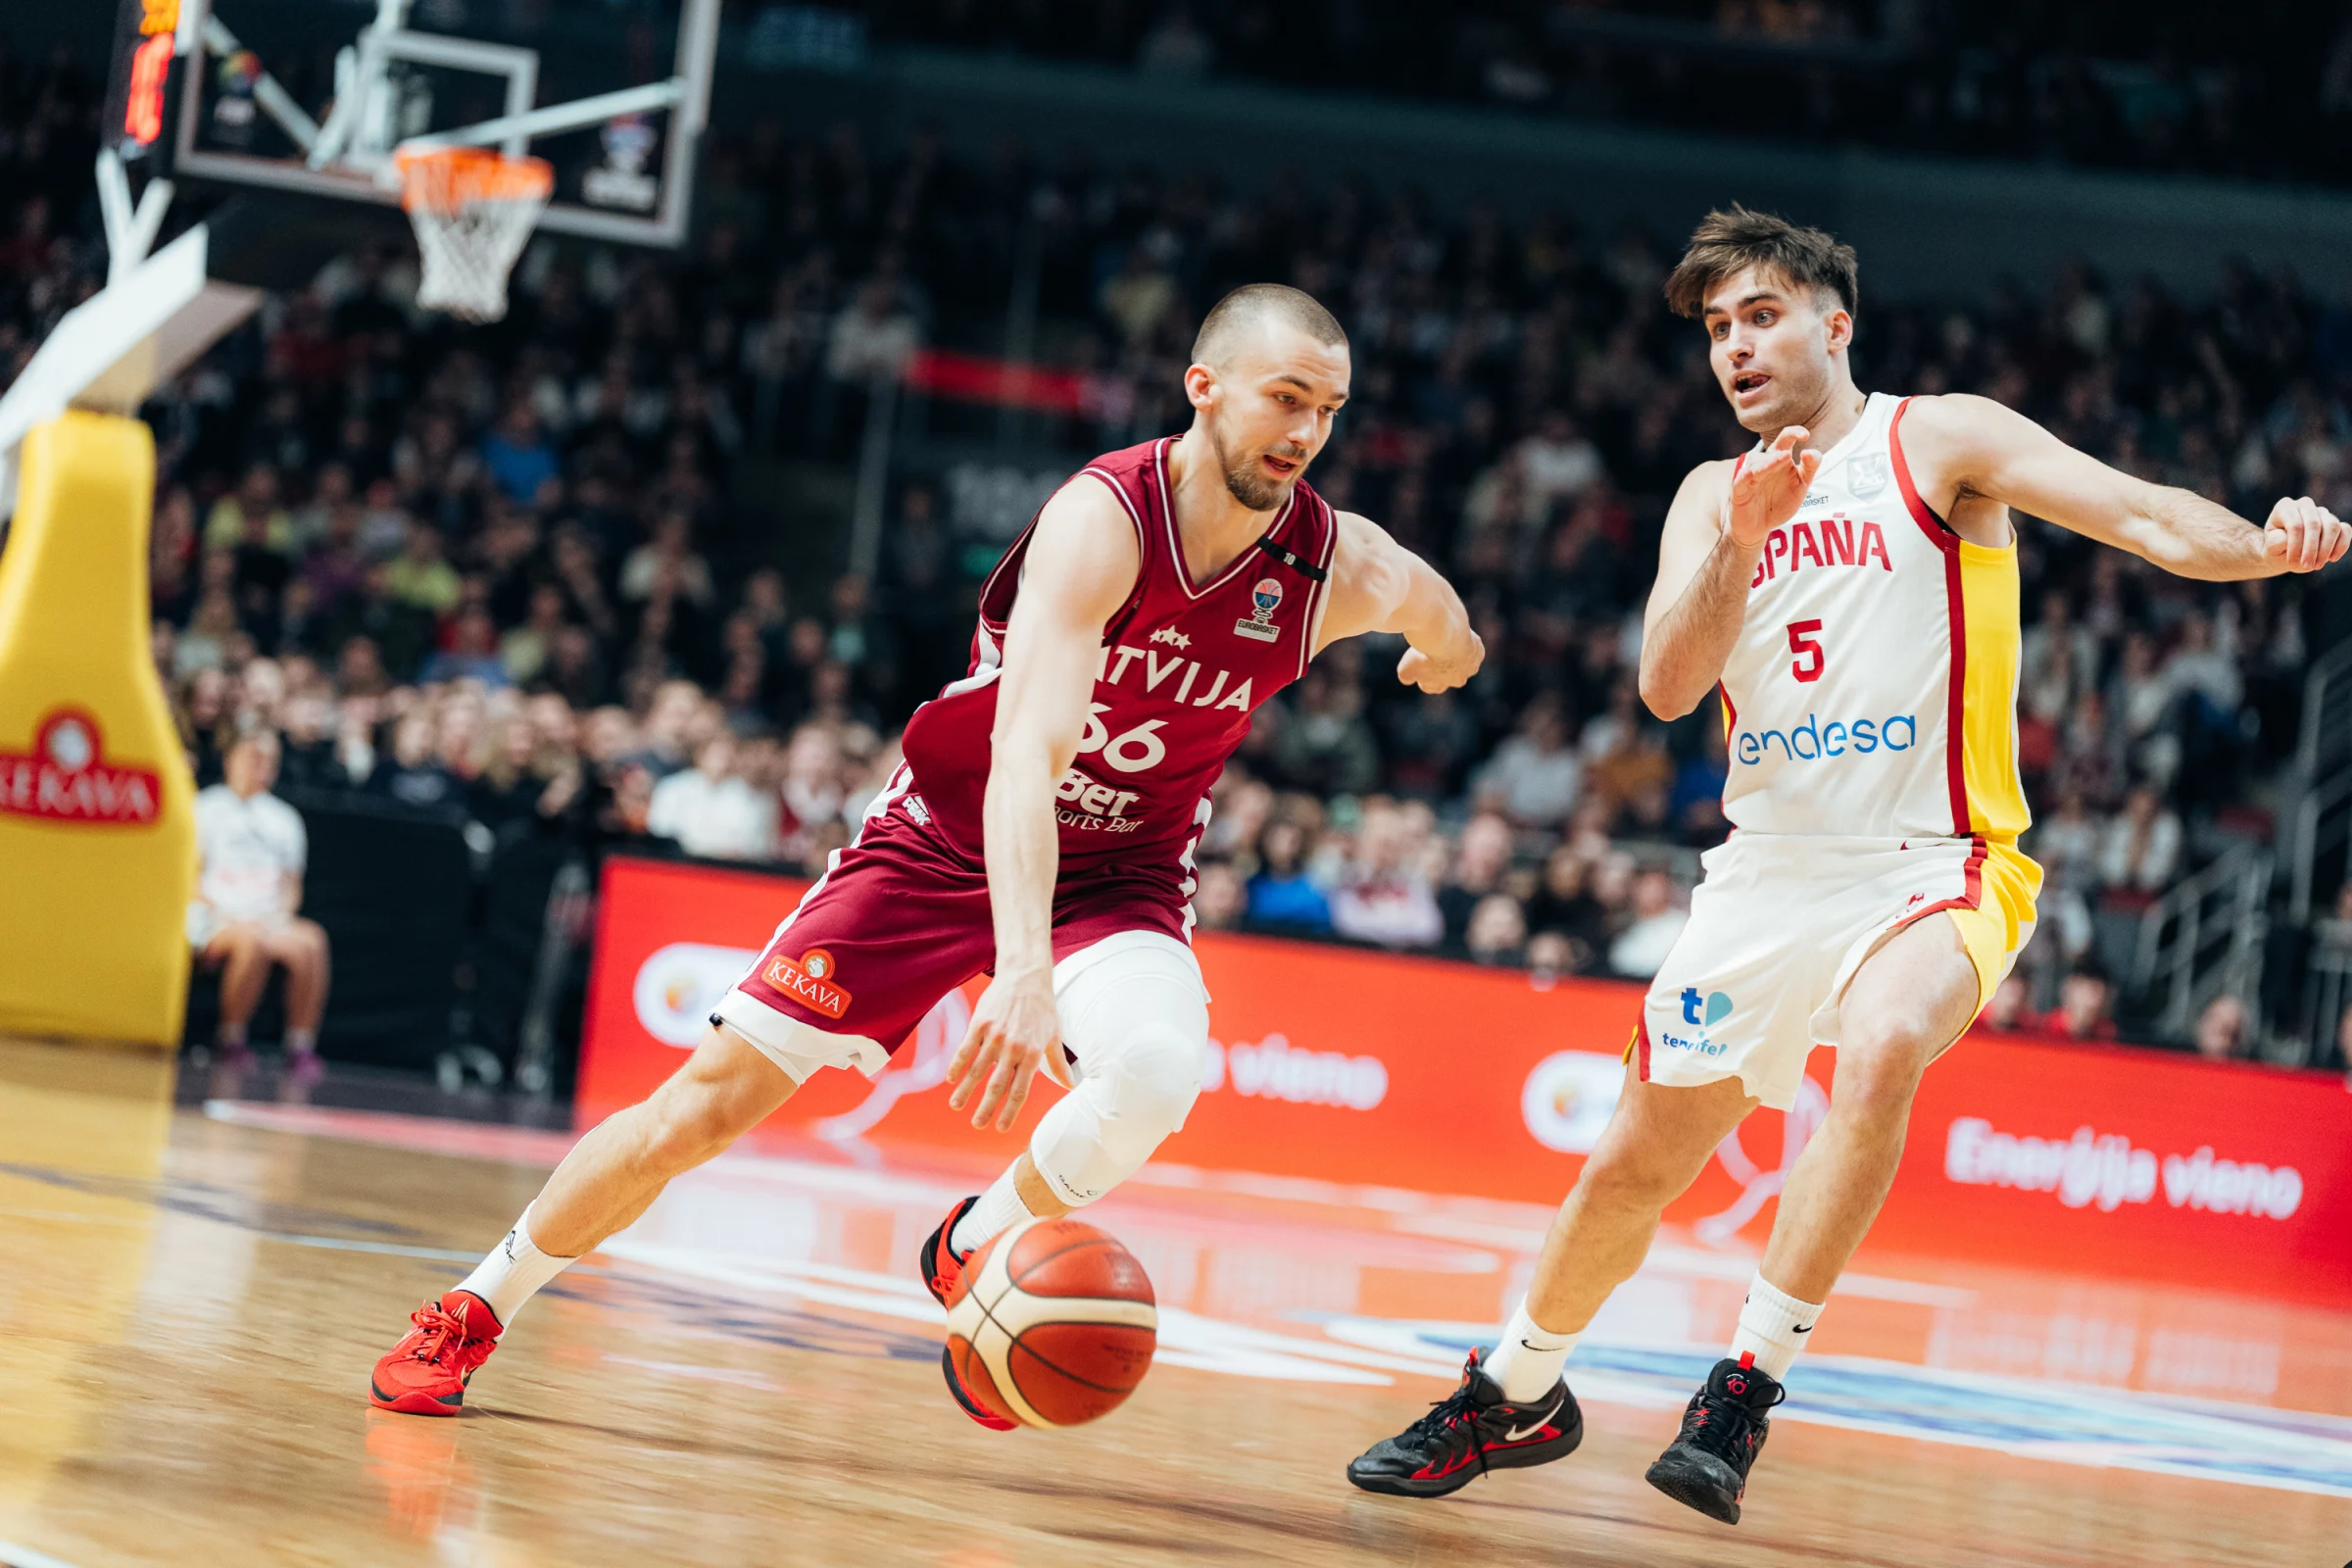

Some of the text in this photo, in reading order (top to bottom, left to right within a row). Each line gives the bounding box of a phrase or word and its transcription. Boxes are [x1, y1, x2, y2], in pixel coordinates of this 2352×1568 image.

[1283, 552, 1297, 565] 10
[1751, 513, 1892, 589] PAÑA
[1238, 619, 1279, 635] EUROBASKET
[1787, 618, 1825, 683] 5
[1096, 645, 1253, 712] TVIJA
[1739, 713, 1916, 765] endesa
[1054, 806, 1144, 833] orts Bar
[768, 961, 842, 1012] ĶEKAVA
[2162, 1146, 2303, 1220] vieno
